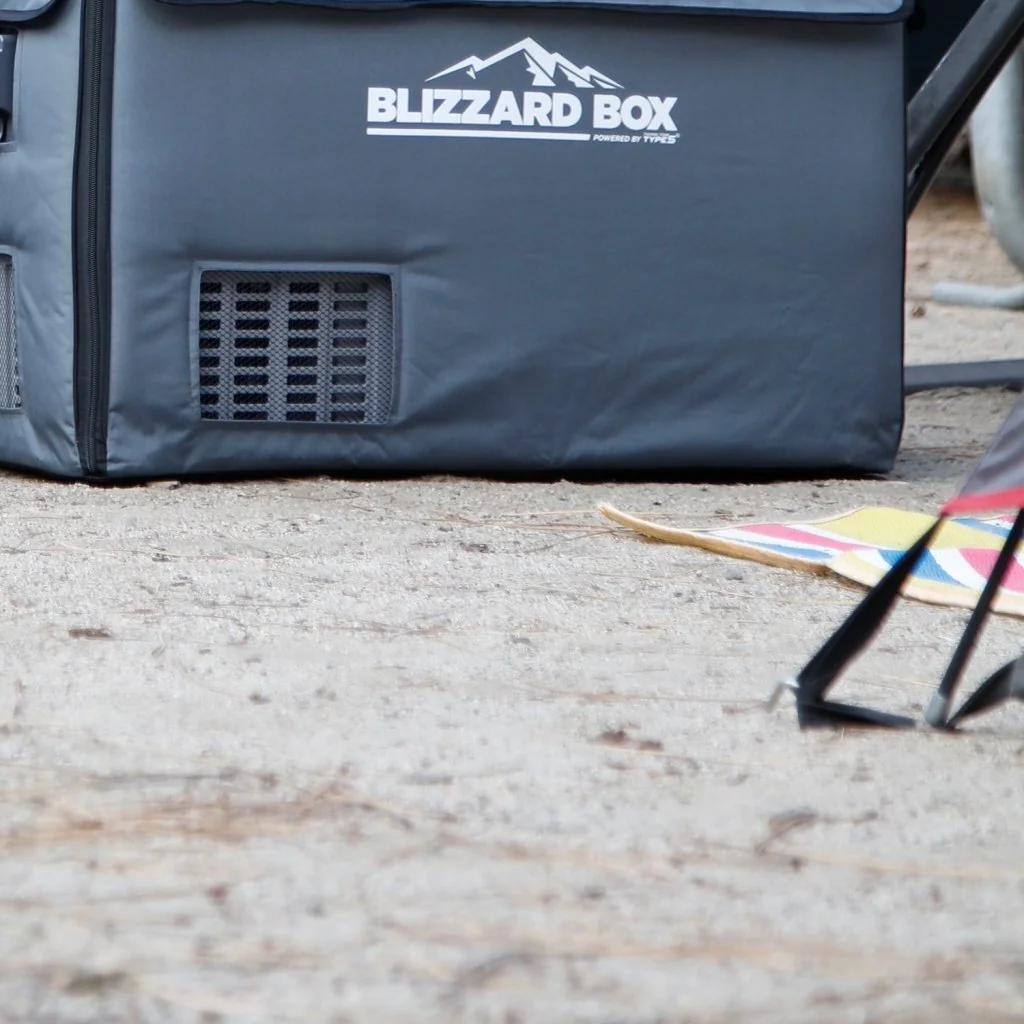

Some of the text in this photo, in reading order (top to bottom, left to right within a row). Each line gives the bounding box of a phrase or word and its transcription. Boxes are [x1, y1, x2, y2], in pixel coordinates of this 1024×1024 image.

[367, 87, 678, 131] BLIZZARD BOX
[593, 134, 630, 143] POWERED
[631, 135, 642, 143] BY
